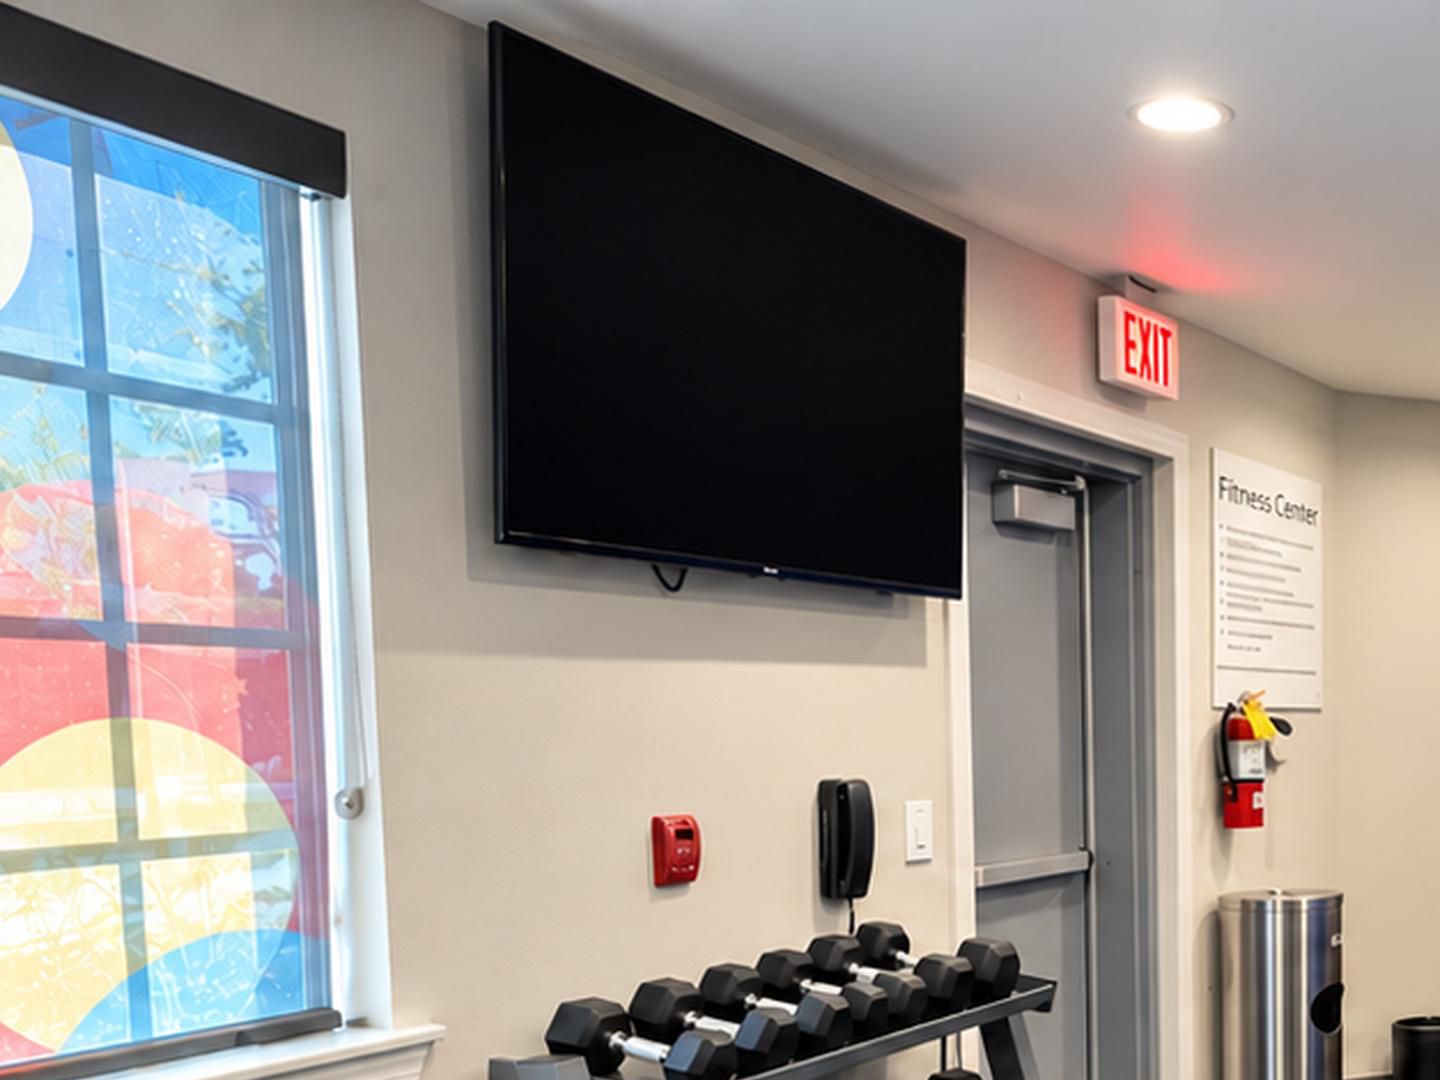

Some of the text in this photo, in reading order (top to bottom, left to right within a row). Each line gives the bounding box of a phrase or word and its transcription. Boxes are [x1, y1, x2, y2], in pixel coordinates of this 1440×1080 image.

[1124, 311, 1172, 387] EXIT
[1219, 476, 1319, 526] Fitness Center
